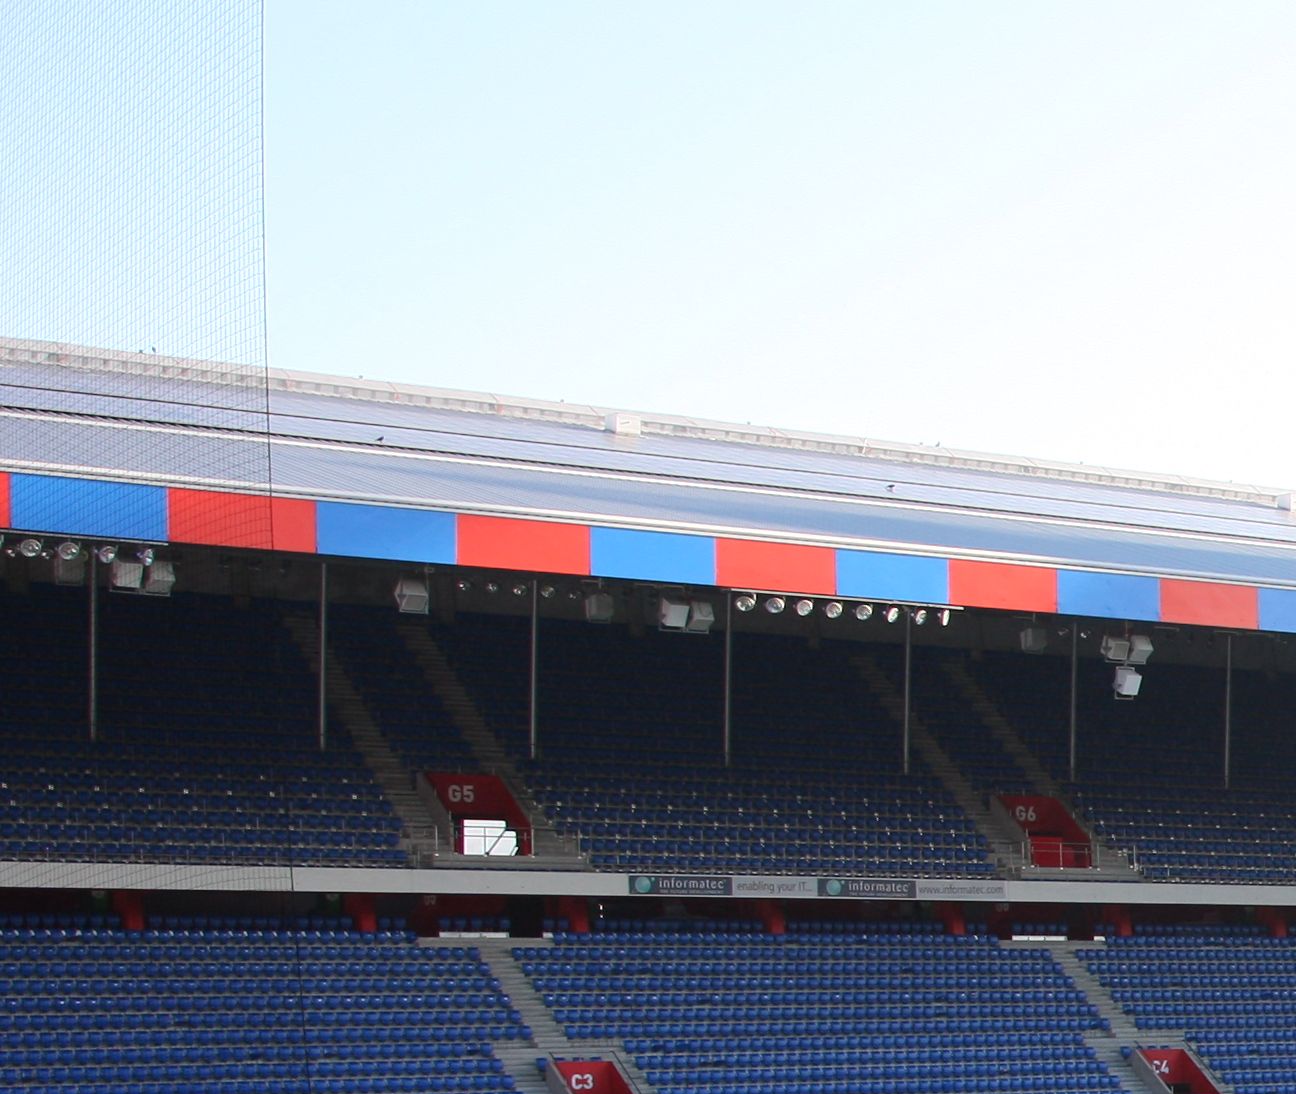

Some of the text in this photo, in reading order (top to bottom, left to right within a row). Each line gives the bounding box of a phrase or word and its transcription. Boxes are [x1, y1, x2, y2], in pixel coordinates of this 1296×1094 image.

[448, 785, 475, 803] G5
[1016, 806, 1037, 822] G6
[659, 877, 724, 889] informatec
[737, 878, 775, 893] enabling
[777, 882, 797, 894] your
[849, 880, 909, 893] informatec
[919, 885, 1004, 896] www.informatec.com
[571, 1074, 593, 1089] C3
